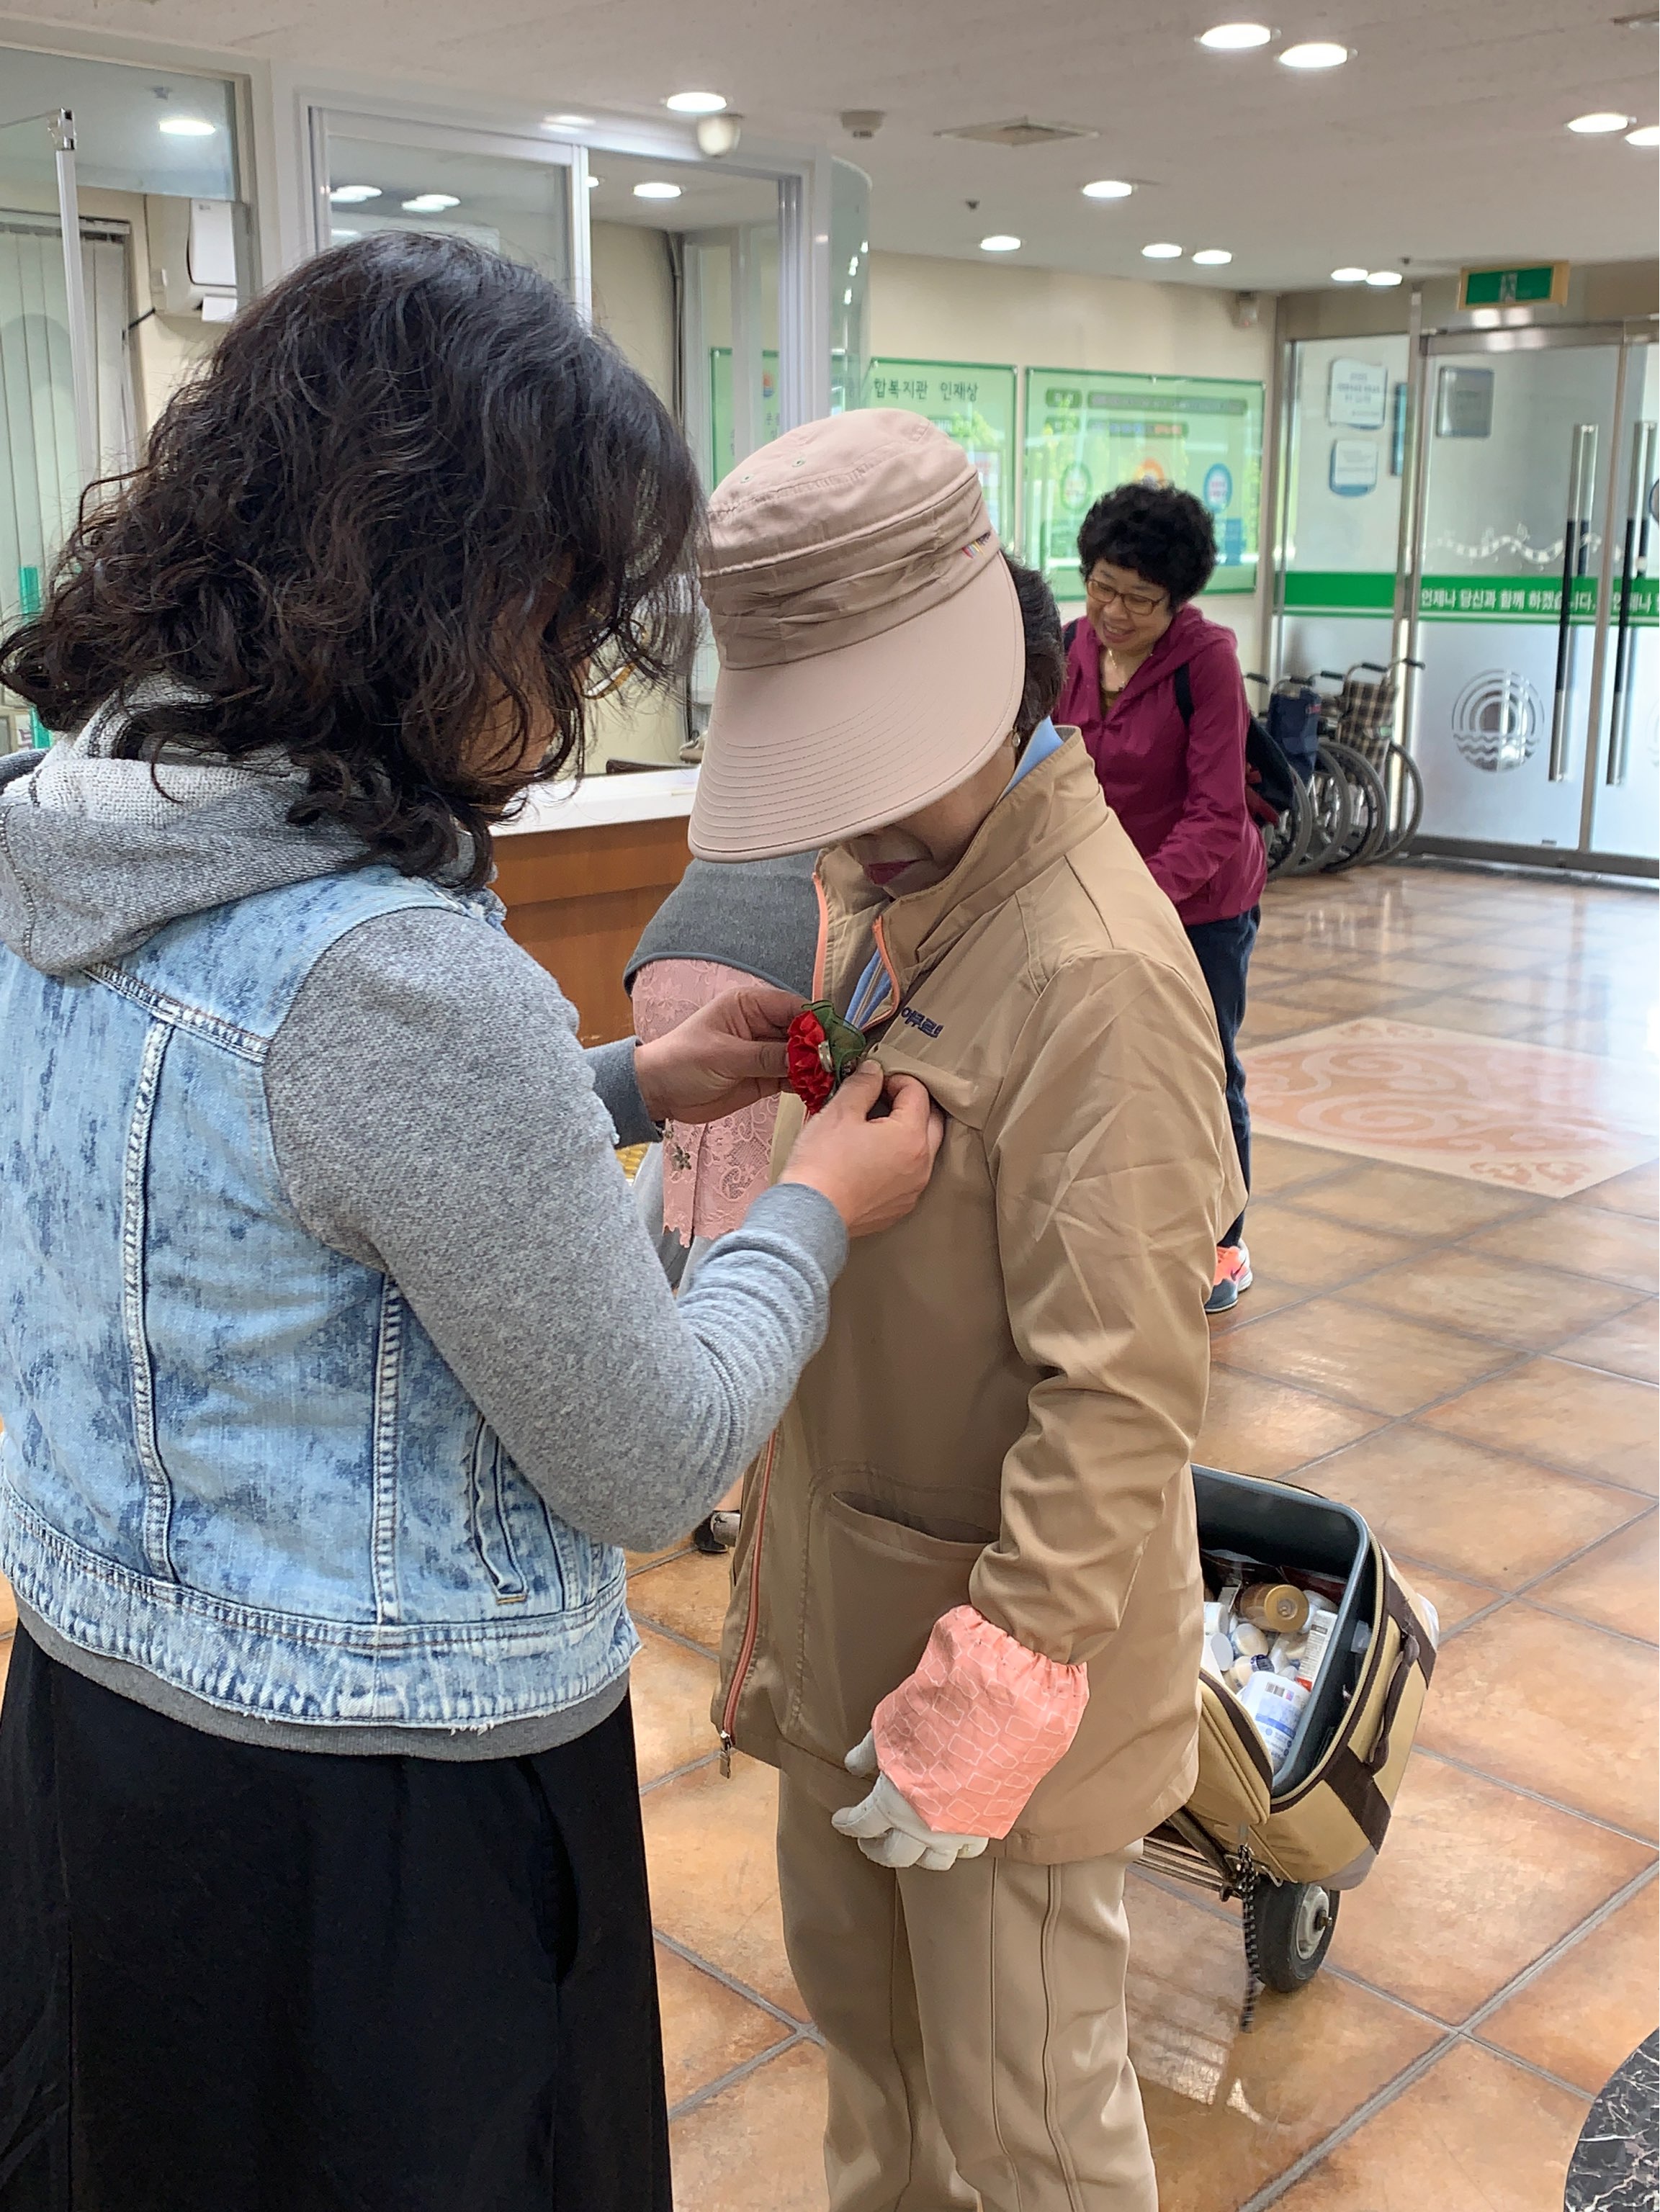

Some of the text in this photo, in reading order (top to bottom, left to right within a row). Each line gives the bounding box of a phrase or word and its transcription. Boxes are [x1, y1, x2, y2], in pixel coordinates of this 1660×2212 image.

[940, 381, 978, 403] 인재상
[1422, 588, 1456, 610] 언제나
[1461, 588, 1497, 611] 당신과
[1500, 588, 1525, 611] 함께
